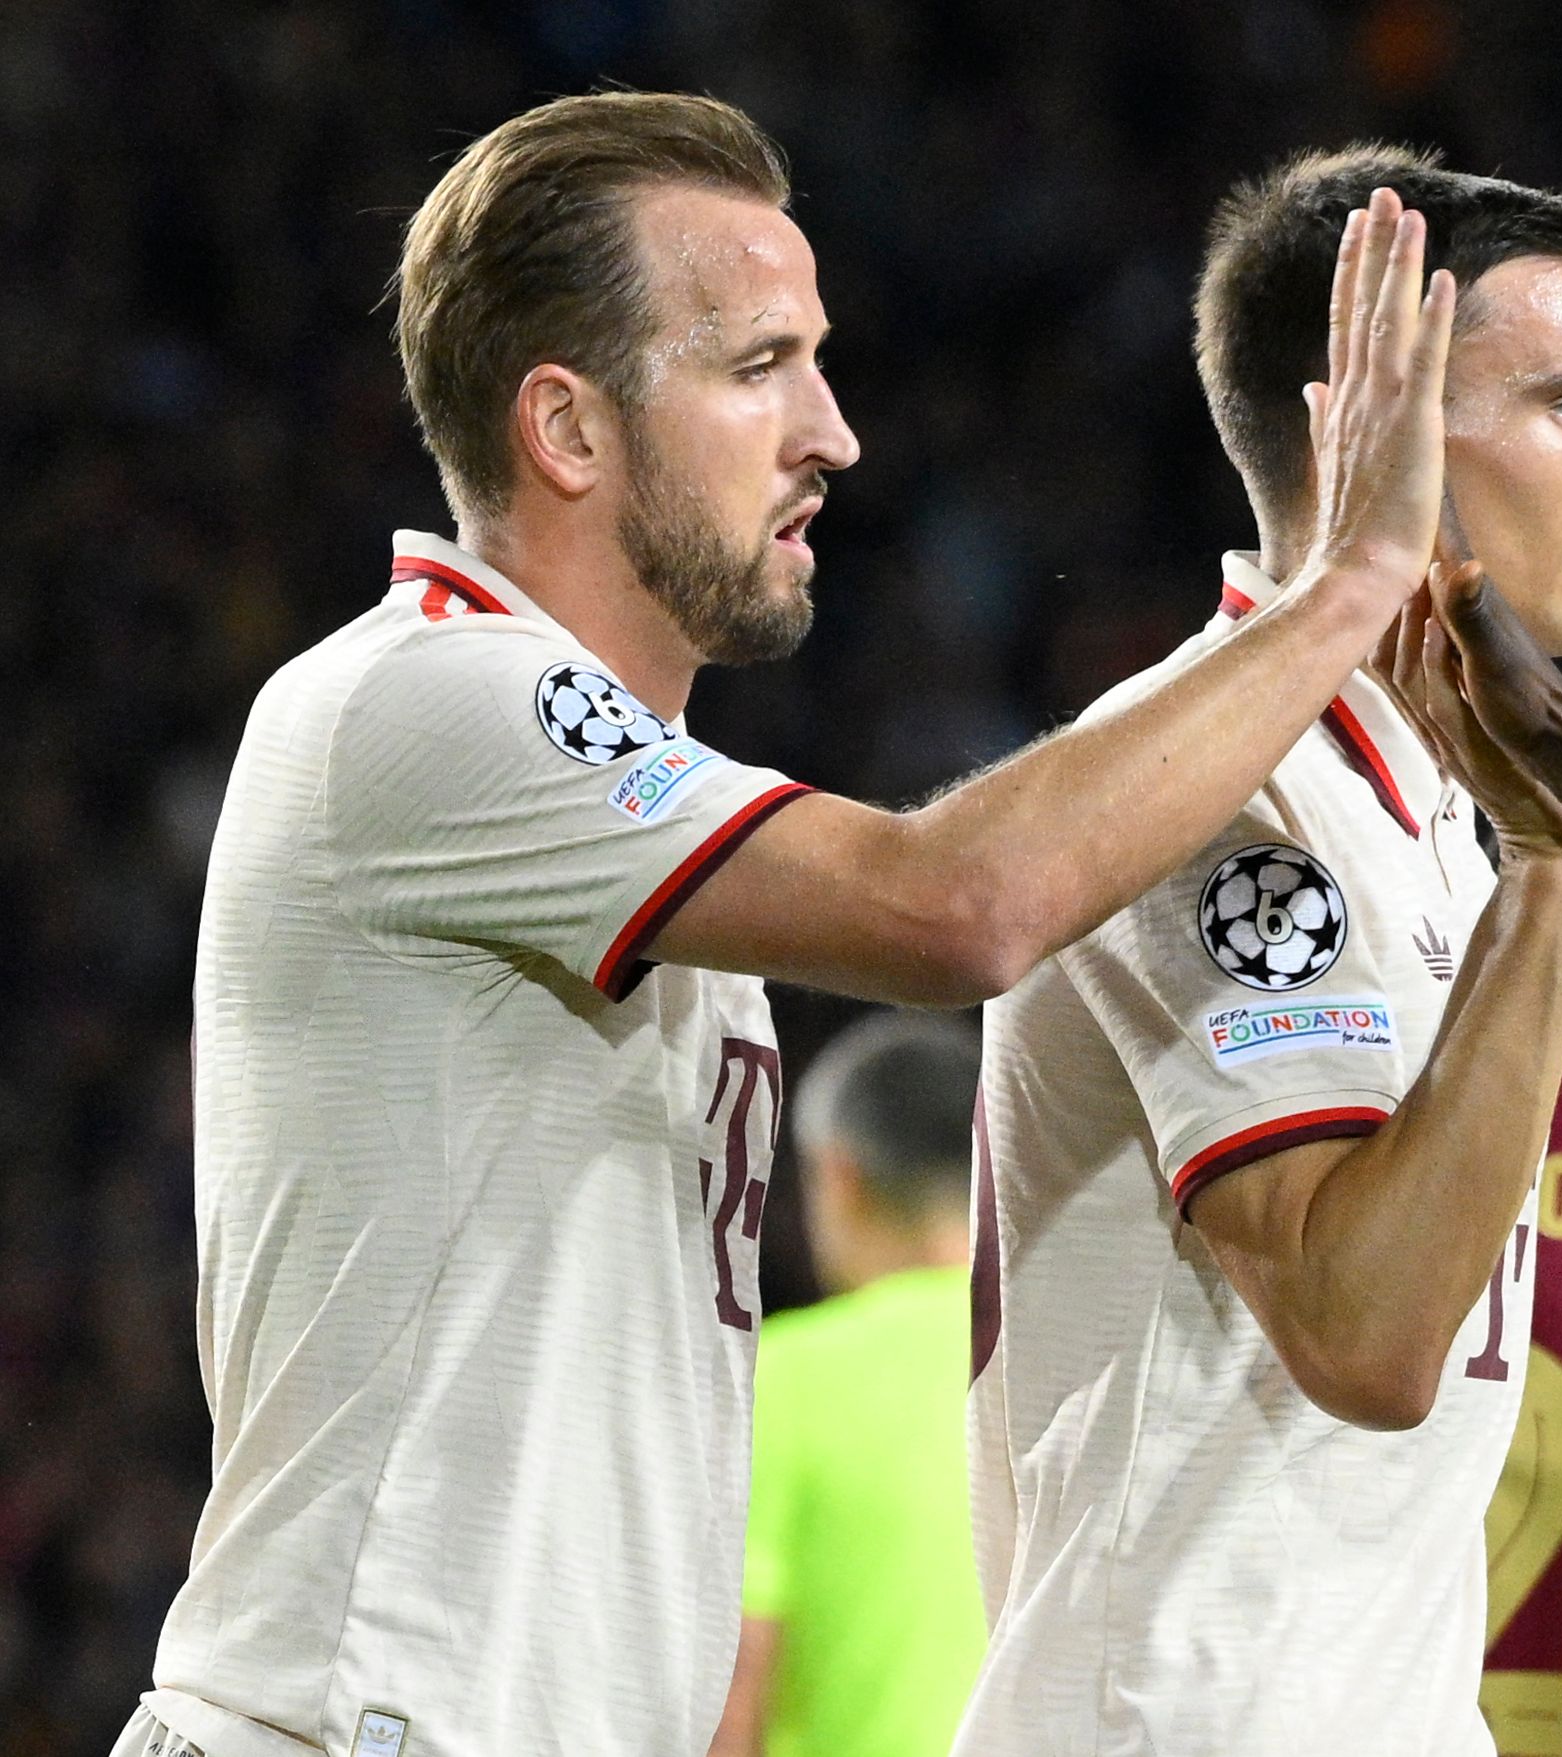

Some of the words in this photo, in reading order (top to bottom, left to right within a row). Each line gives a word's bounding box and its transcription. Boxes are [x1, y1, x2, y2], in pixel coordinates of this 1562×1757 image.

[588, 689, 637, 728] 6
[613, 768, 645, 804] UEFA
[1255, 889, 1295, 945] 6
[1208, 1009, 1249, 1028] UEFA
[1211, 1010, 1390, 1048] FOUNDATION
[1342, 1030, 1355, 1046] for
[1357, 1032, 1391, 1045] children
